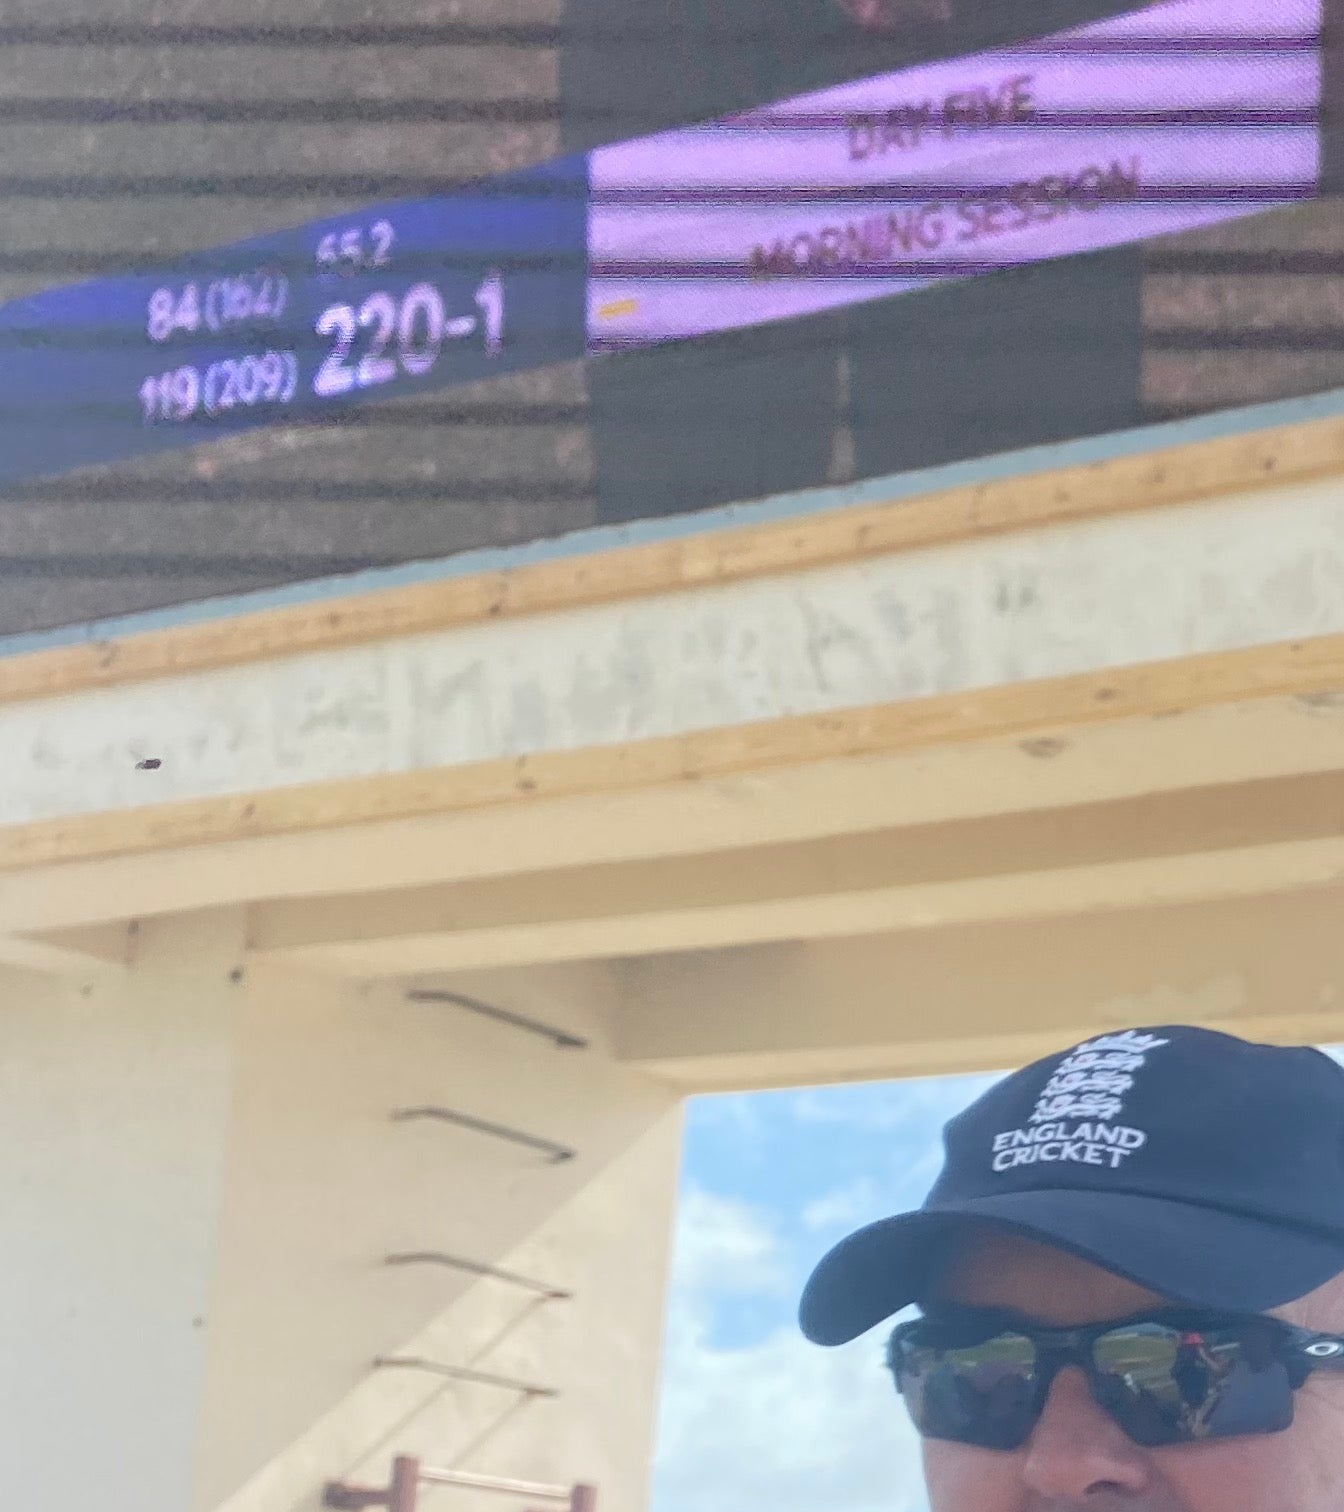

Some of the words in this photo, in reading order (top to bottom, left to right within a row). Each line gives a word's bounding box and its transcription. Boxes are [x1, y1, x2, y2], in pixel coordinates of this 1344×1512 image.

[847, 102, 932, 163] DAY
[942, 74, 1034, 139] FIVE
[748, 200, 946, 281] MORNING
[954, 156, 1141, 242] SESSION
[991, 1122, 1147, 1152] ENGLAND
[991, 1141, 1131, 1172] CRICKET
